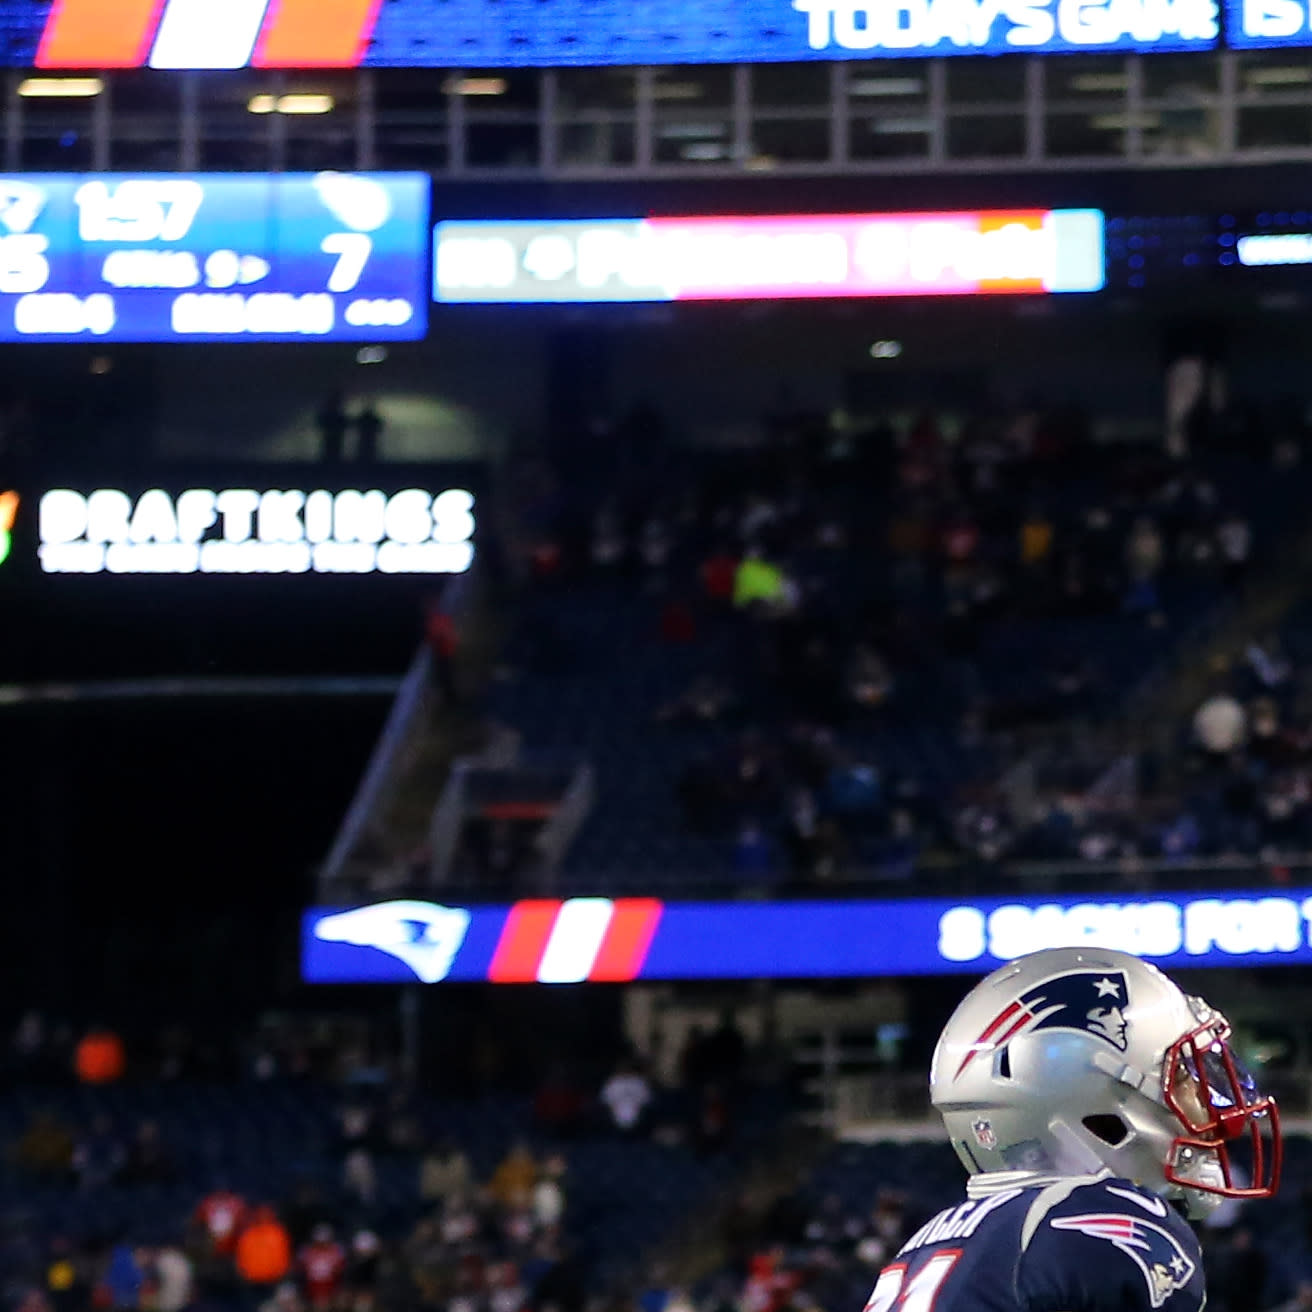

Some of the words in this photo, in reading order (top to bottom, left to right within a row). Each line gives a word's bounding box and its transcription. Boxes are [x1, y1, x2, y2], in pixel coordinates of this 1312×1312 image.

[320, 233, 372, 292] 7
[40, 490, 474, 544] DRAFTKINGS
[1185, 899, 1299, 954] FOR
